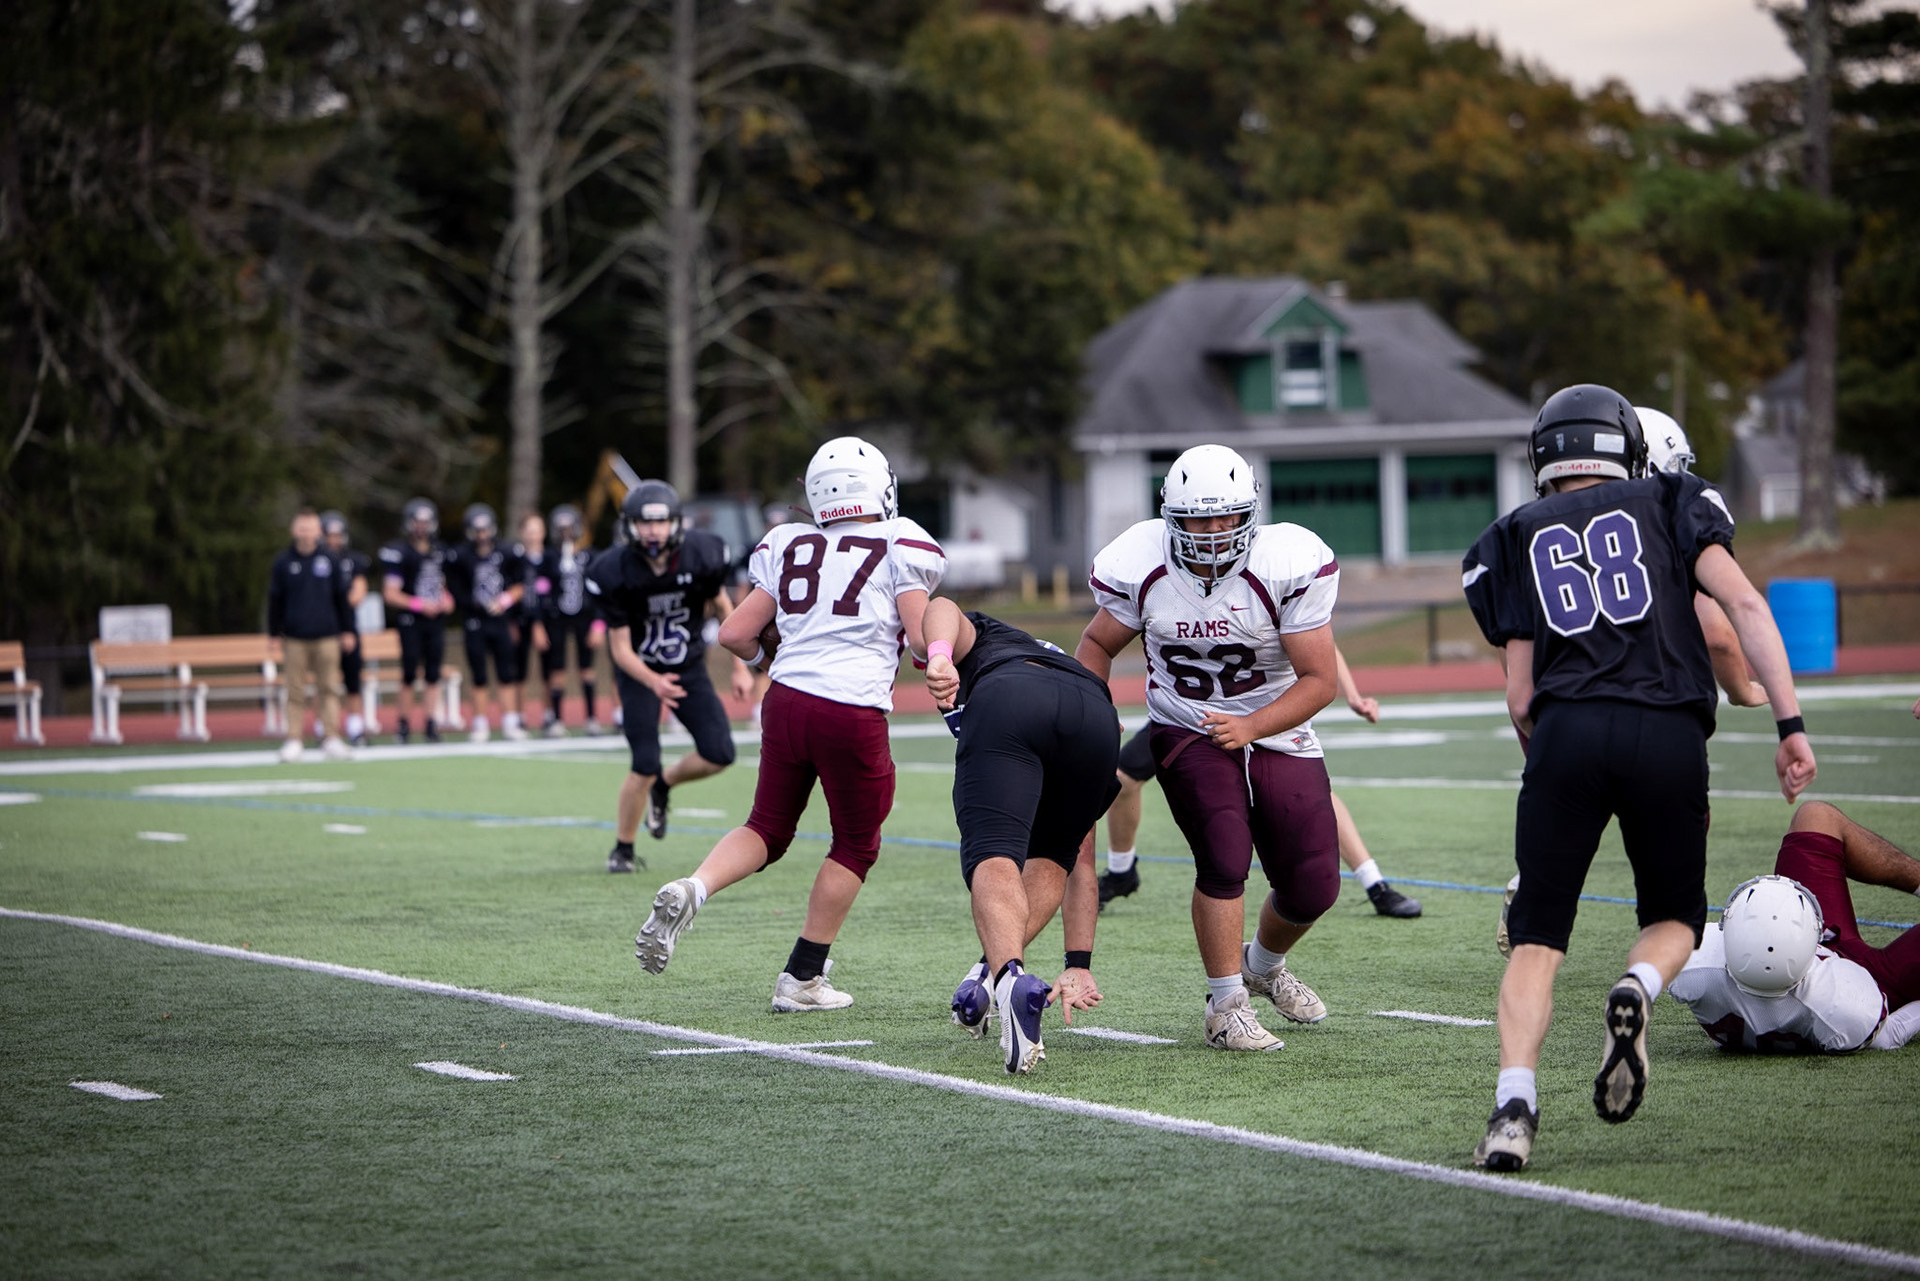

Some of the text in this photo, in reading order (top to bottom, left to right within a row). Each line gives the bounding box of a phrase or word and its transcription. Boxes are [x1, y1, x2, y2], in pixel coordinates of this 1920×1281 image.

[820, 505, 863, 520] Riddell
[779, 533, 888, 617] 87
[1529, 509, 1653, 637] 68
[638, 607, 691, 665] 15
[1176, 620, 1230, 639] RAMS
[1160, 643, 1268, 701] 62
